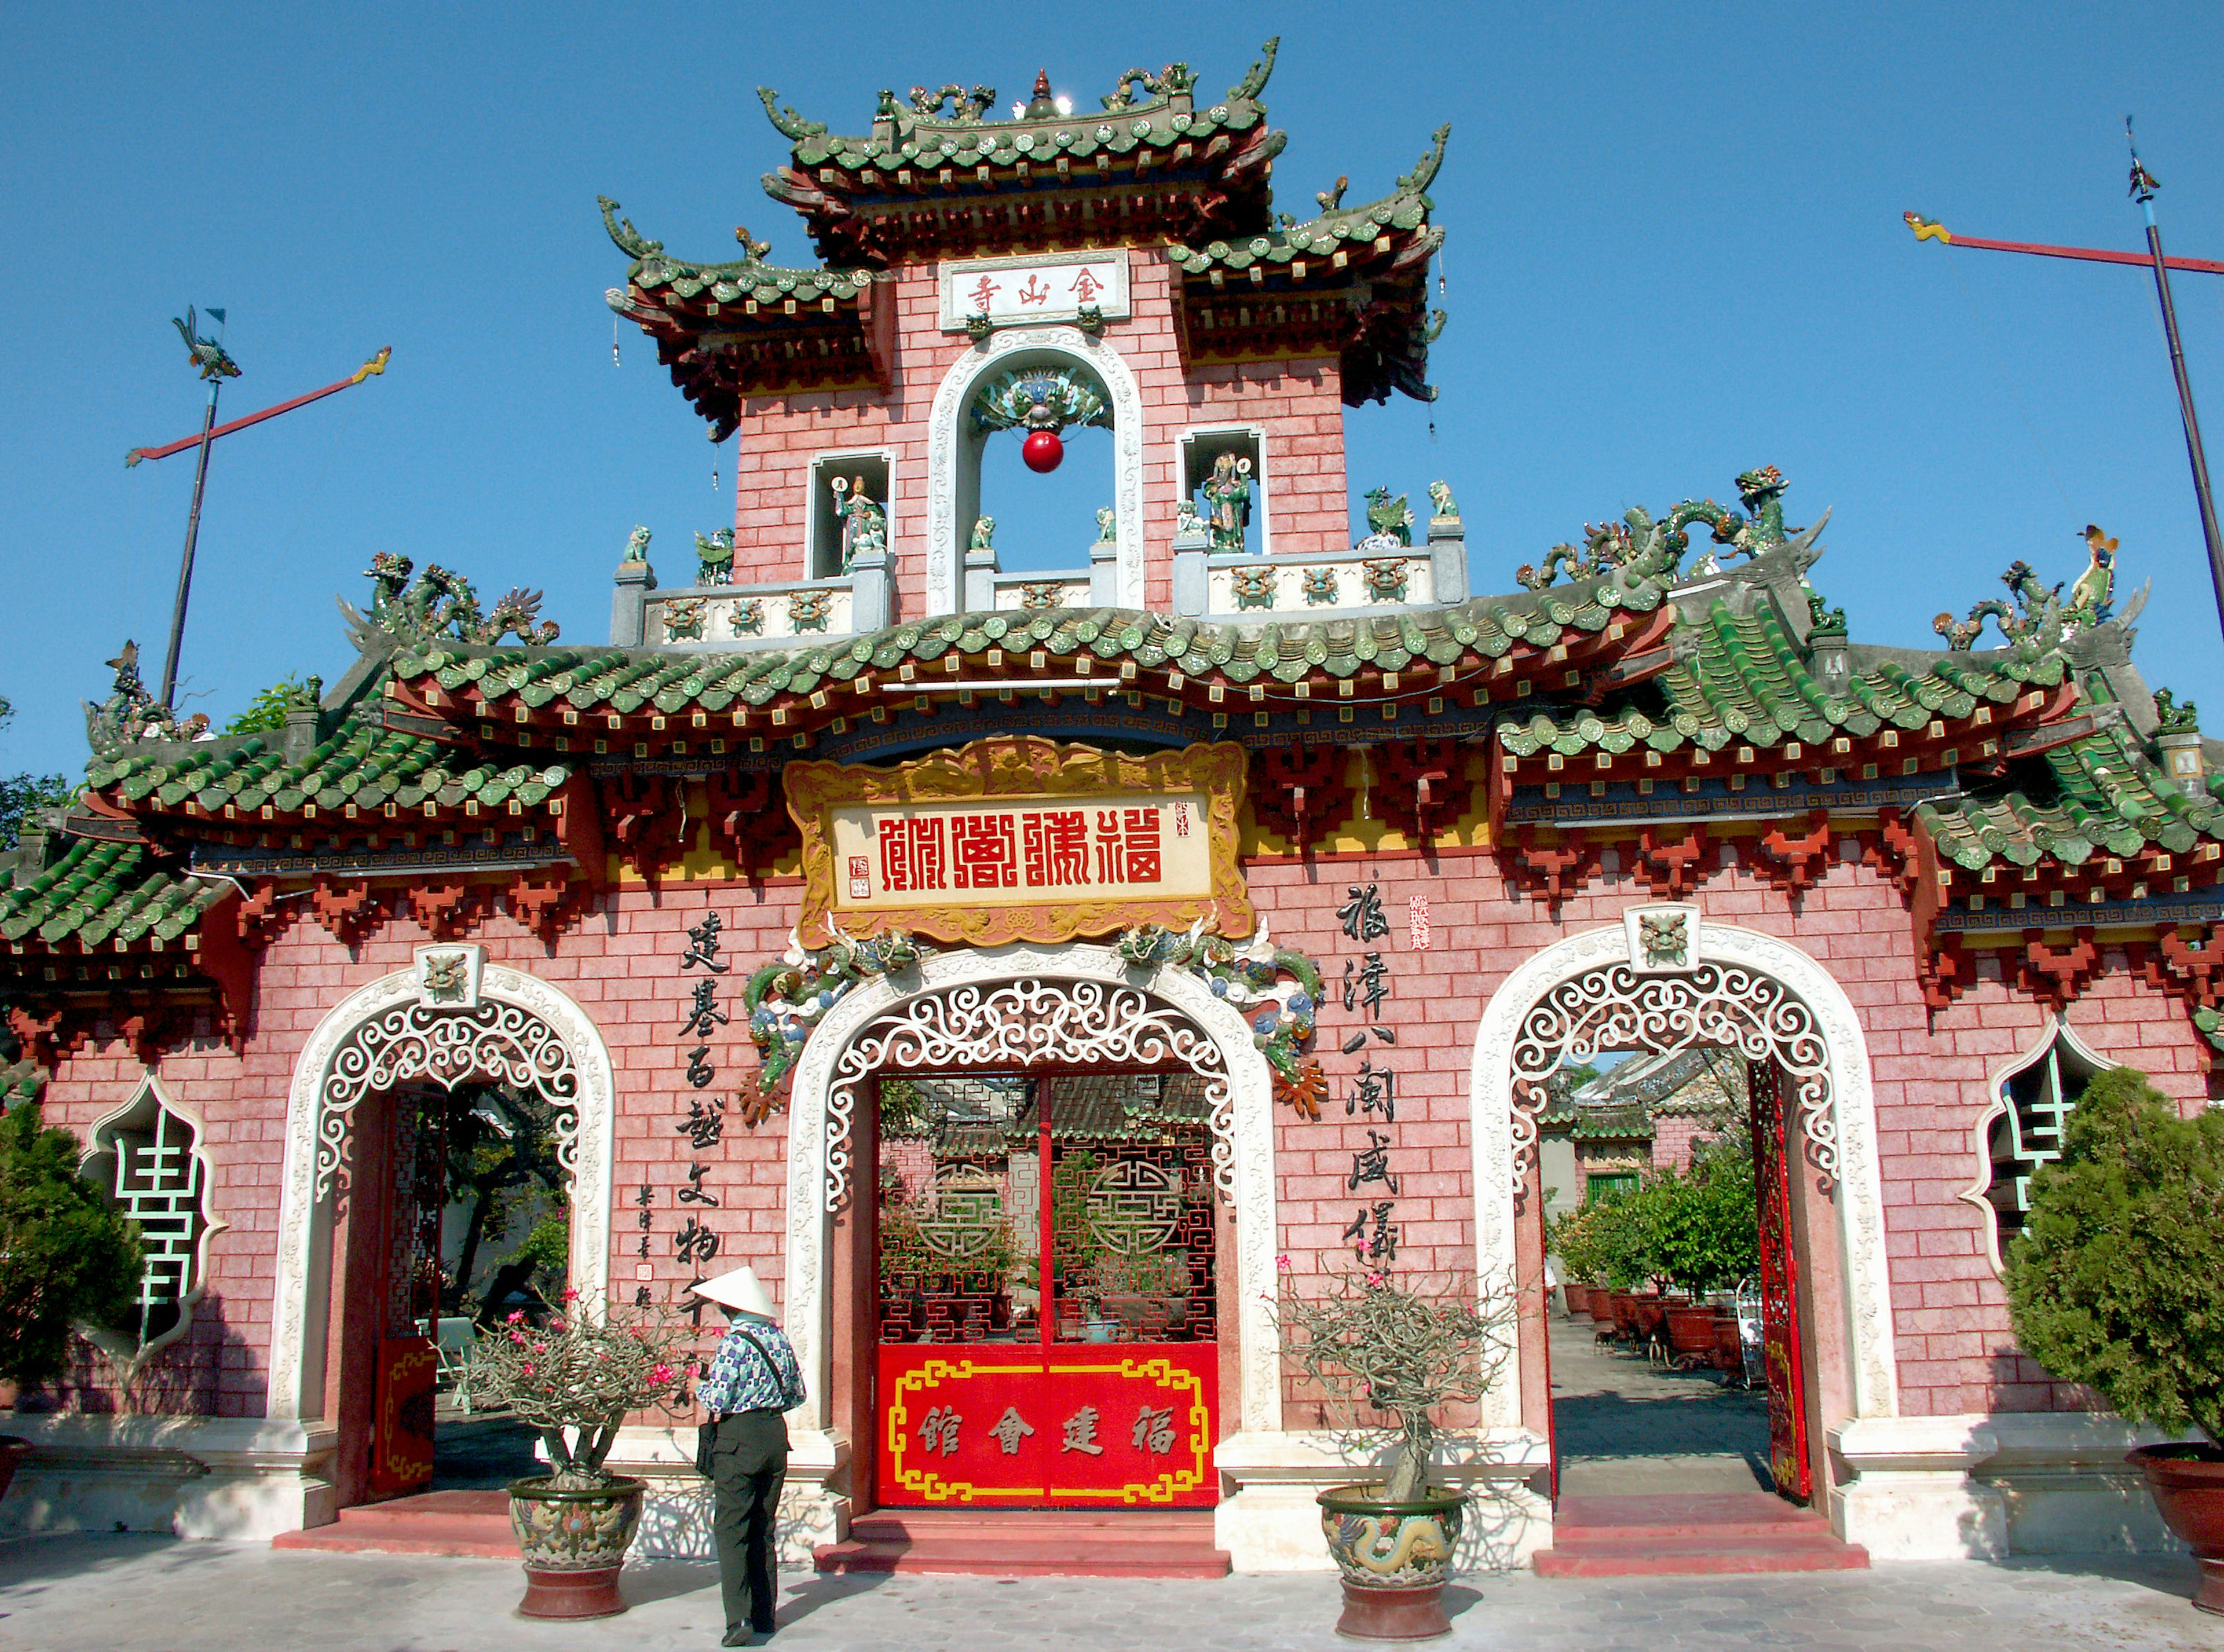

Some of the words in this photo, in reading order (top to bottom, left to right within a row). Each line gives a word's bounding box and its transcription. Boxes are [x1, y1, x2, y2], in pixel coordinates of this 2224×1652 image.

[968, 267, 1104, 313] 金山寺
[1336, 884, 1398, 1409] 福澤八閩威儀
[917, 1405, 1177, 1457] 福建會館
